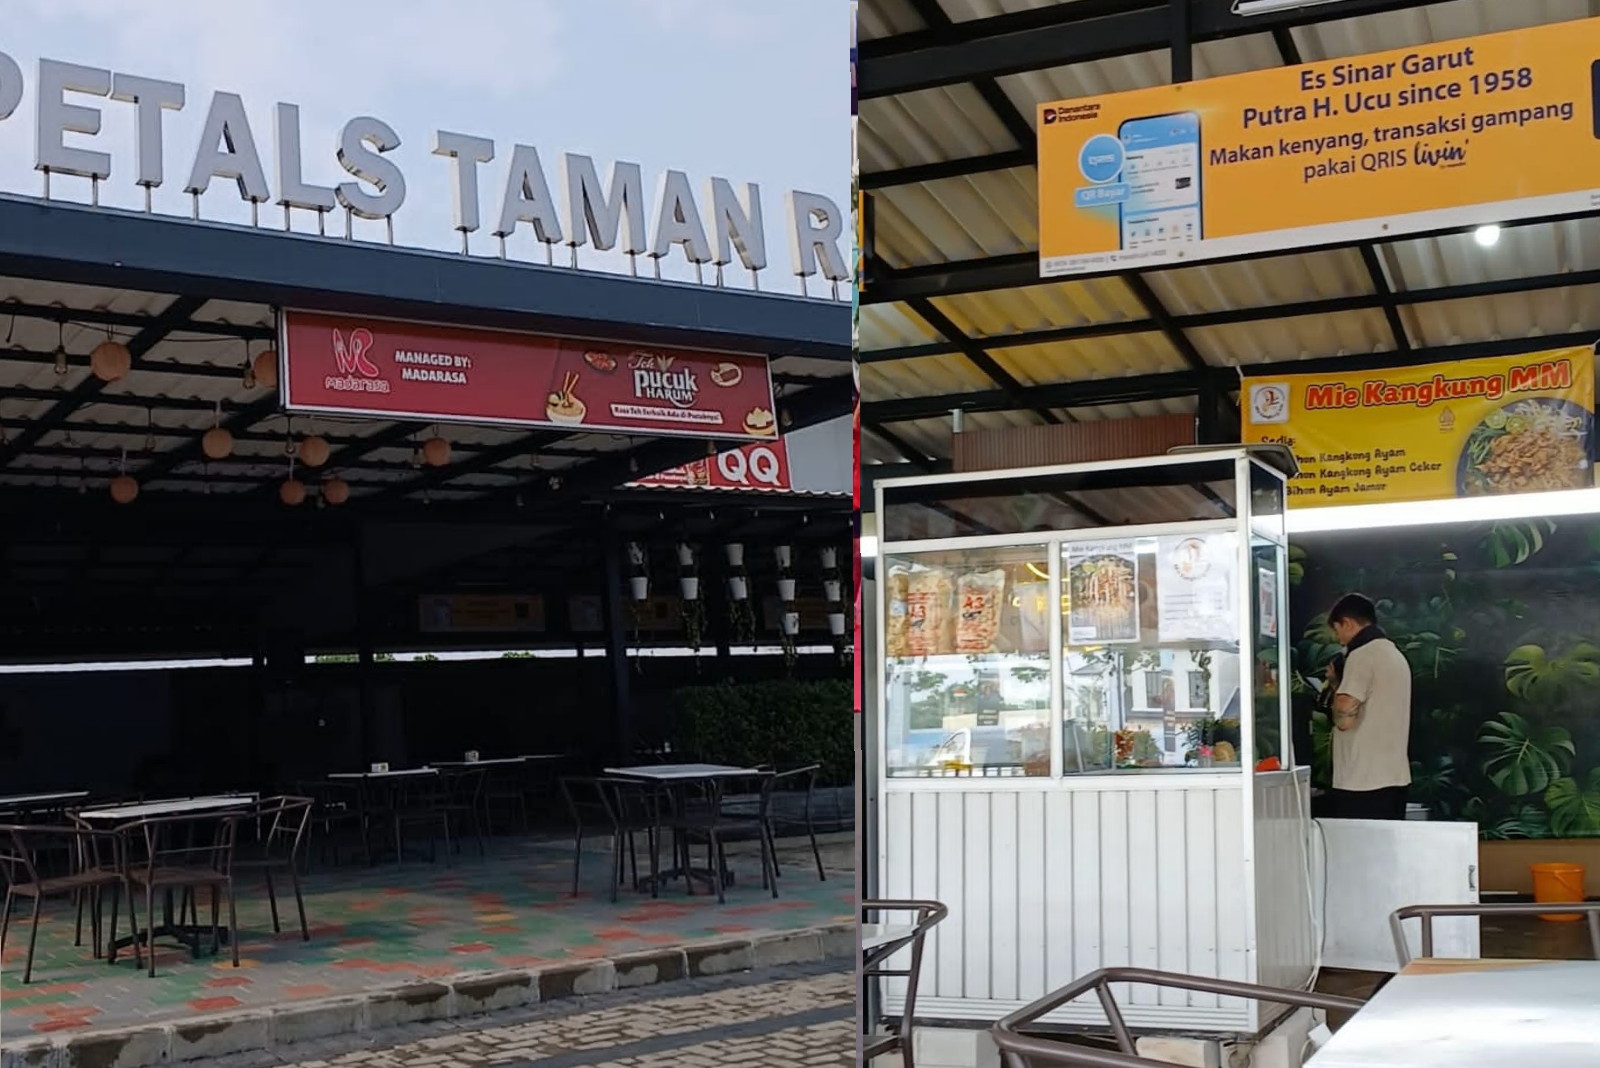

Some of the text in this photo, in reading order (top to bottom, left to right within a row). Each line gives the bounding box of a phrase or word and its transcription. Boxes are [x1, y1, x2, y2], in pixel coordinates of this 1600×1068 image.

[1301, 47, 1475, 92] Es Sinar Garut
[1243, 66, 1534, 130] Putra H. Ucu since 1958
[1058, 111, 1098, 123] Indonesia
[1209, 100, 1575, 167] Makan kenyang, transaksi gampang
[1303, 158, 1357, 185] pakai
[1361, 147, 1408, 176] QRIS
[431, 129, 768, 271] TAMAN
[394, 350, 472, 369] MANAGED BY:
[401, 367, 468, 385] MADARASA
[1304, 382, 1360, 412] Mie
[1362, 372, 1504, 407] Kangkung
[1508, 358, 1573, 391] MM
[646, 387, 696, 405] HARUM
[717, 447, 782, 486] QQ
[1375, 447, 1406, 462] Ayam
[1375, 464, 1407, 478] Ayam
[1319, 484, 1350, 497] Ayam
